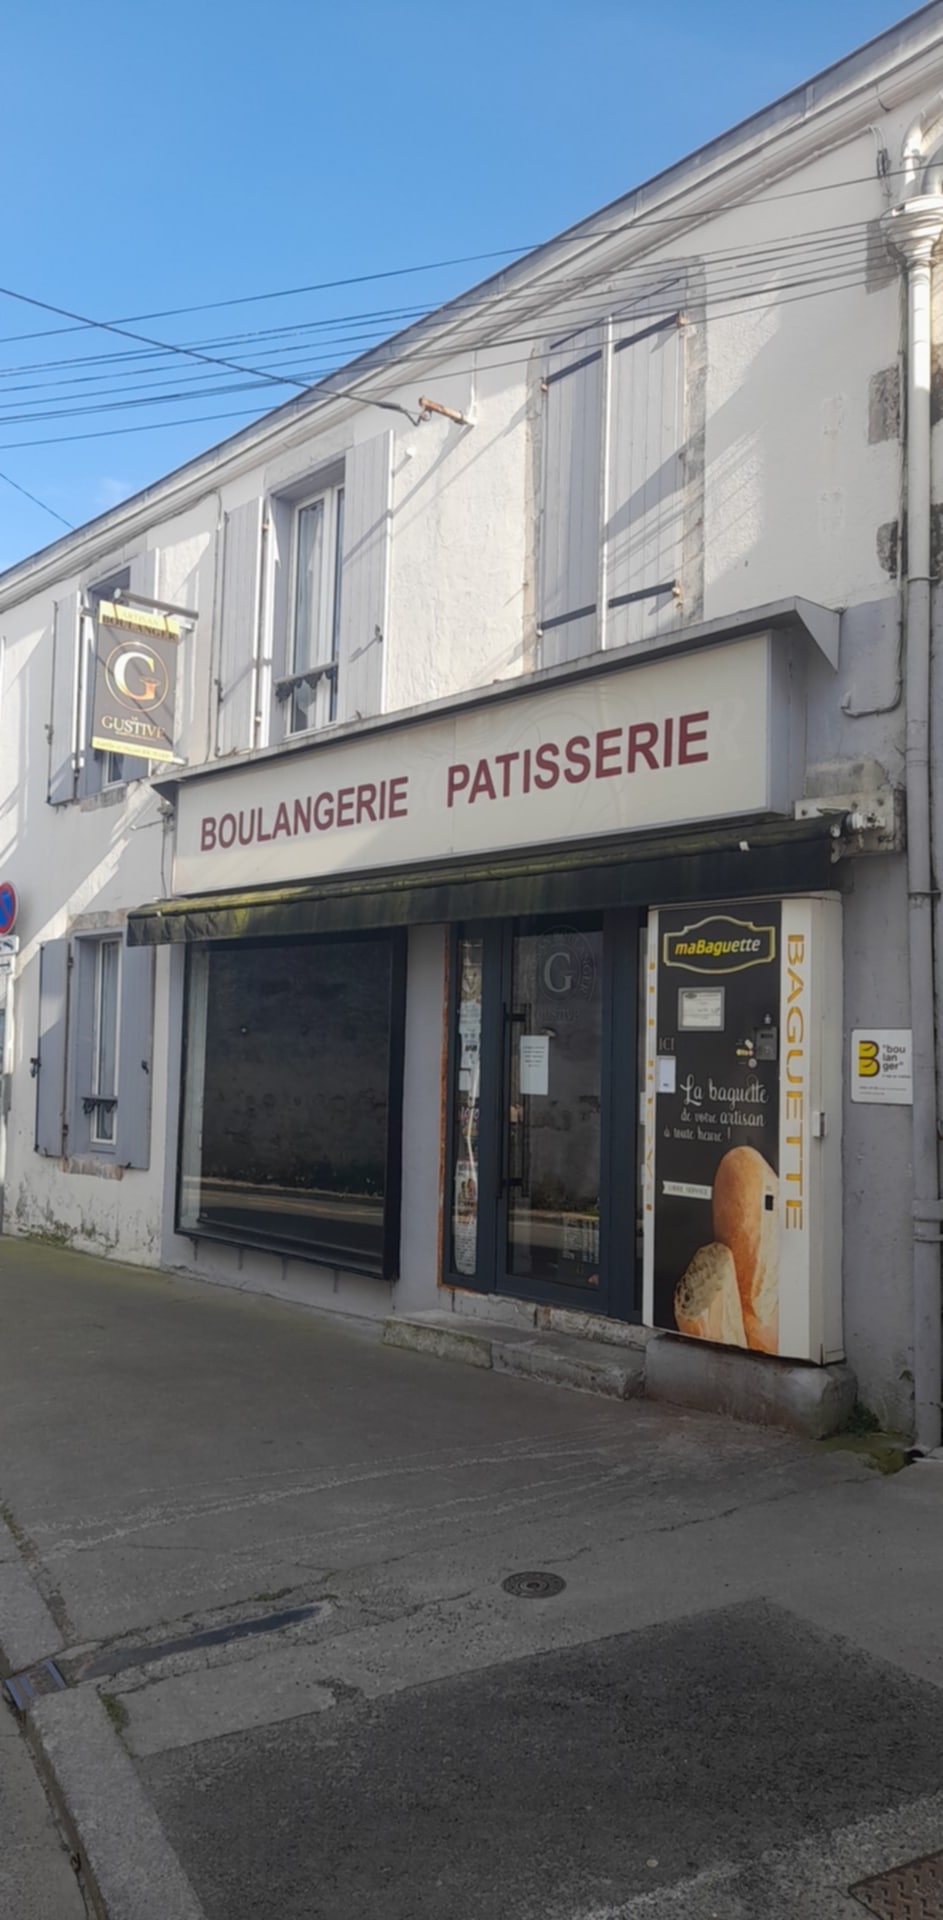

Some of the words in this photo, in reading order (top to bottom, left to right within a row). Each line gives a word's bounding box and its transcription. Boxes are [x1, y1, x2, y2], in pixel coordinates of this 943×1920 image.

[102, 614, 178, 641] BOULANGER
[113, 652, 161, 701] G
[201, 776, 409, 852] BOULANGERIE
[447, 710, 710, 808] PATISSERIE
[674, 938, 761, 957] maBaguette
[543, 952, 577, 993] G
[659, 1037, 675, 1051] ICI
[680, 1074, 703, 1107] La
[708, 1077, 770, 1110] baguette
[786, 935, 804, 1231] BAGUETTE
[681, 1108, 693, 1122] de
[695, 1112, 718, 1123] votre
[720, 1111, 767, 1127] artisan
[673, 1127, 695, 1140] toute
[697, 1126, 723, 1143] heure
[685, 1187, 708, 1196] SERVICE
